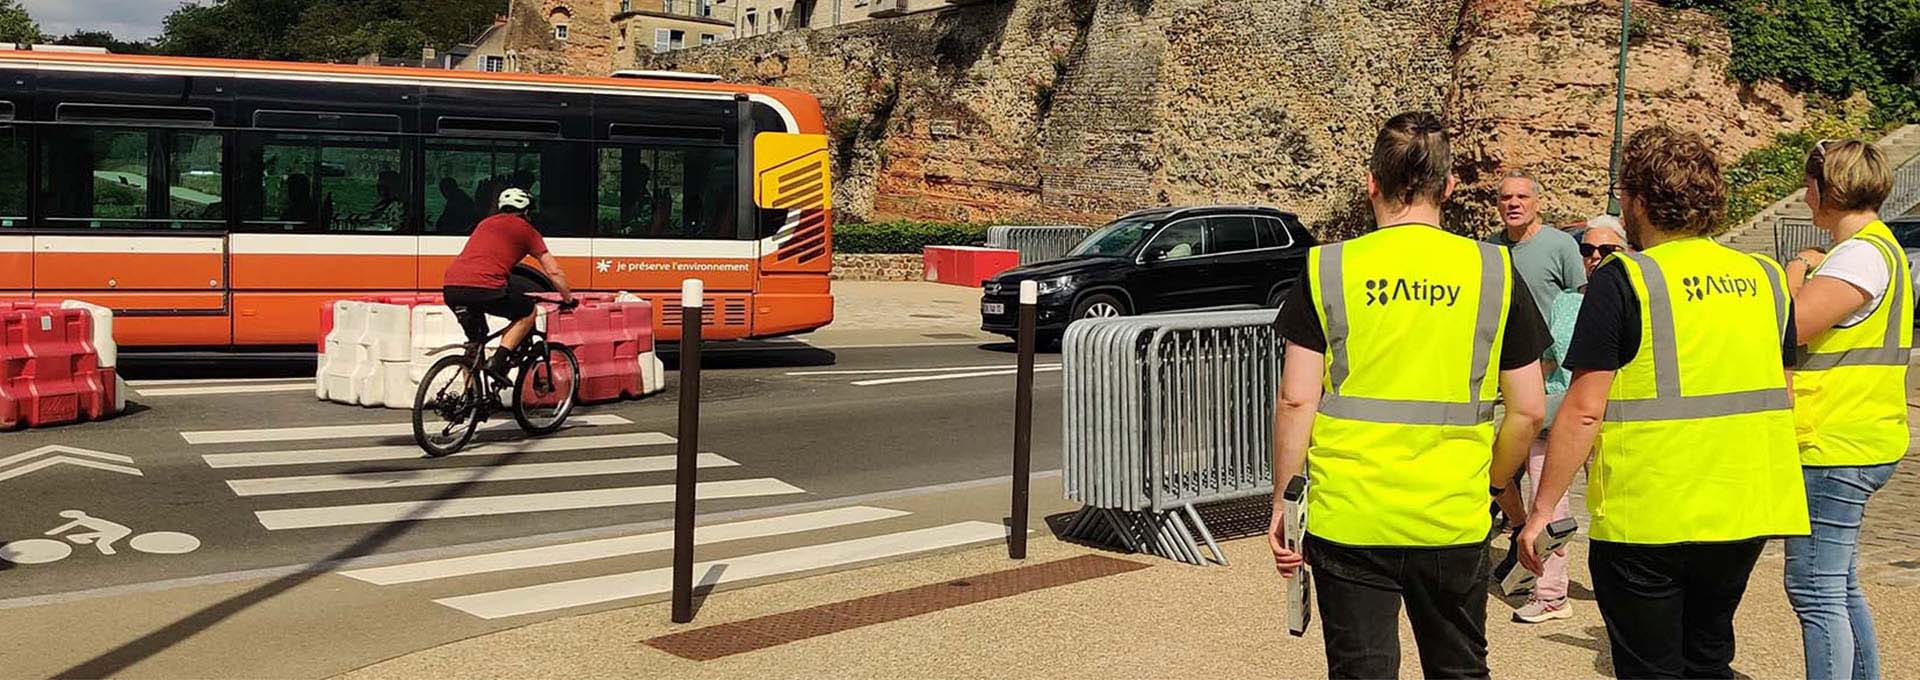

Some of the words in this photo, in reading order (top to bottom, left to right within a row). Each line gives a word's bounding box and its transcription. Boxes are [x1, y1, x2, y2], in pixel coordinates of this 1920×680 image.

[628, 261, 671, 272] préserve
[672, 261, 749, 272] l'environnement
[1391, 278, 1461, 306] Atipy
[1706, 273, 1757, 297] Atipy
